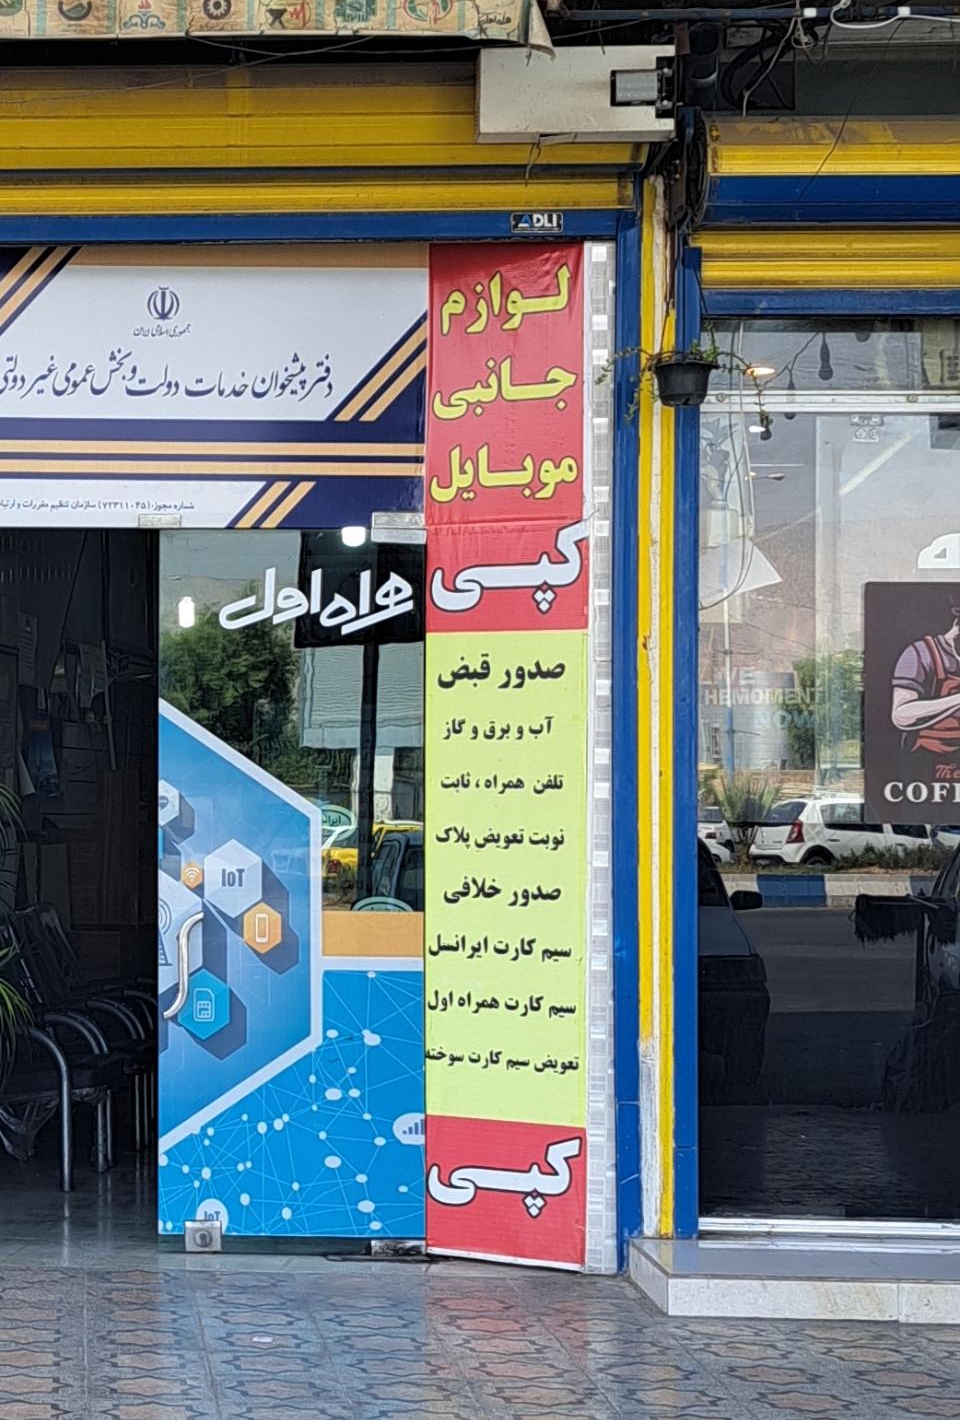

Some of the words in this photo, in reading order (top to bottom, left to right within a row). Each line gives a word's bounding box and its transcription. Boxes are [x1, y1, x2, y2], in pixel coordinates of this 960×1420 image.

[517, 213, 558, 228] ADLI
[441, 264, 571, 336] لوازم
[125, 364, 180, 397] دولت
[185, 371, 249, 398] خدمات
[251, 352, 307, 399] پیشخوان
[298, 353, 333, 402] دفتر
[432, 356, 577, 420] جانبی
[429, 443, 578, 503] موبایل
[430, 518, 590, 614] کپی
[218, 567, 322, 630] اول
[437, 653, 491, 690] قبض
[497, 659, 566, 689] صدور
[483, 720, 510, 740] برق
[528, 716, 554, 737] آب
[440, 772, 471, 792] ثابت
[484, 774, 525, 794] همراه
[533, 774, 563, 794] تلفن
[435, 826, 470, 849] پلاک
[474, 828, 524, 850] تعویض
[529, 829, 565, 850] نوبت
[221, 868, 245, 888] IoT
[444, 876, 501, 903] خلافی
[507, 885, 561, 906] صدور
[428, 934, 488, 959] ایرانسل
[493, 937, 536, 961] کارت
[541, 948, 572, 962] سیم
[427, 990, 453, 1011] اول
[458, 991, 500, 1014] همراه
[504, 995, 544, 1017] کارت
[548, 1005, 576, 1018] سیم
[425, 1047, 464, 1067] سوخته
[468, 1051, 502, 1069] کارت
[506, 1059, 530, 1070] سیم
[534, 1055, 579, 1074] تعویض
[427, 1137, 581, 1219] کپی
